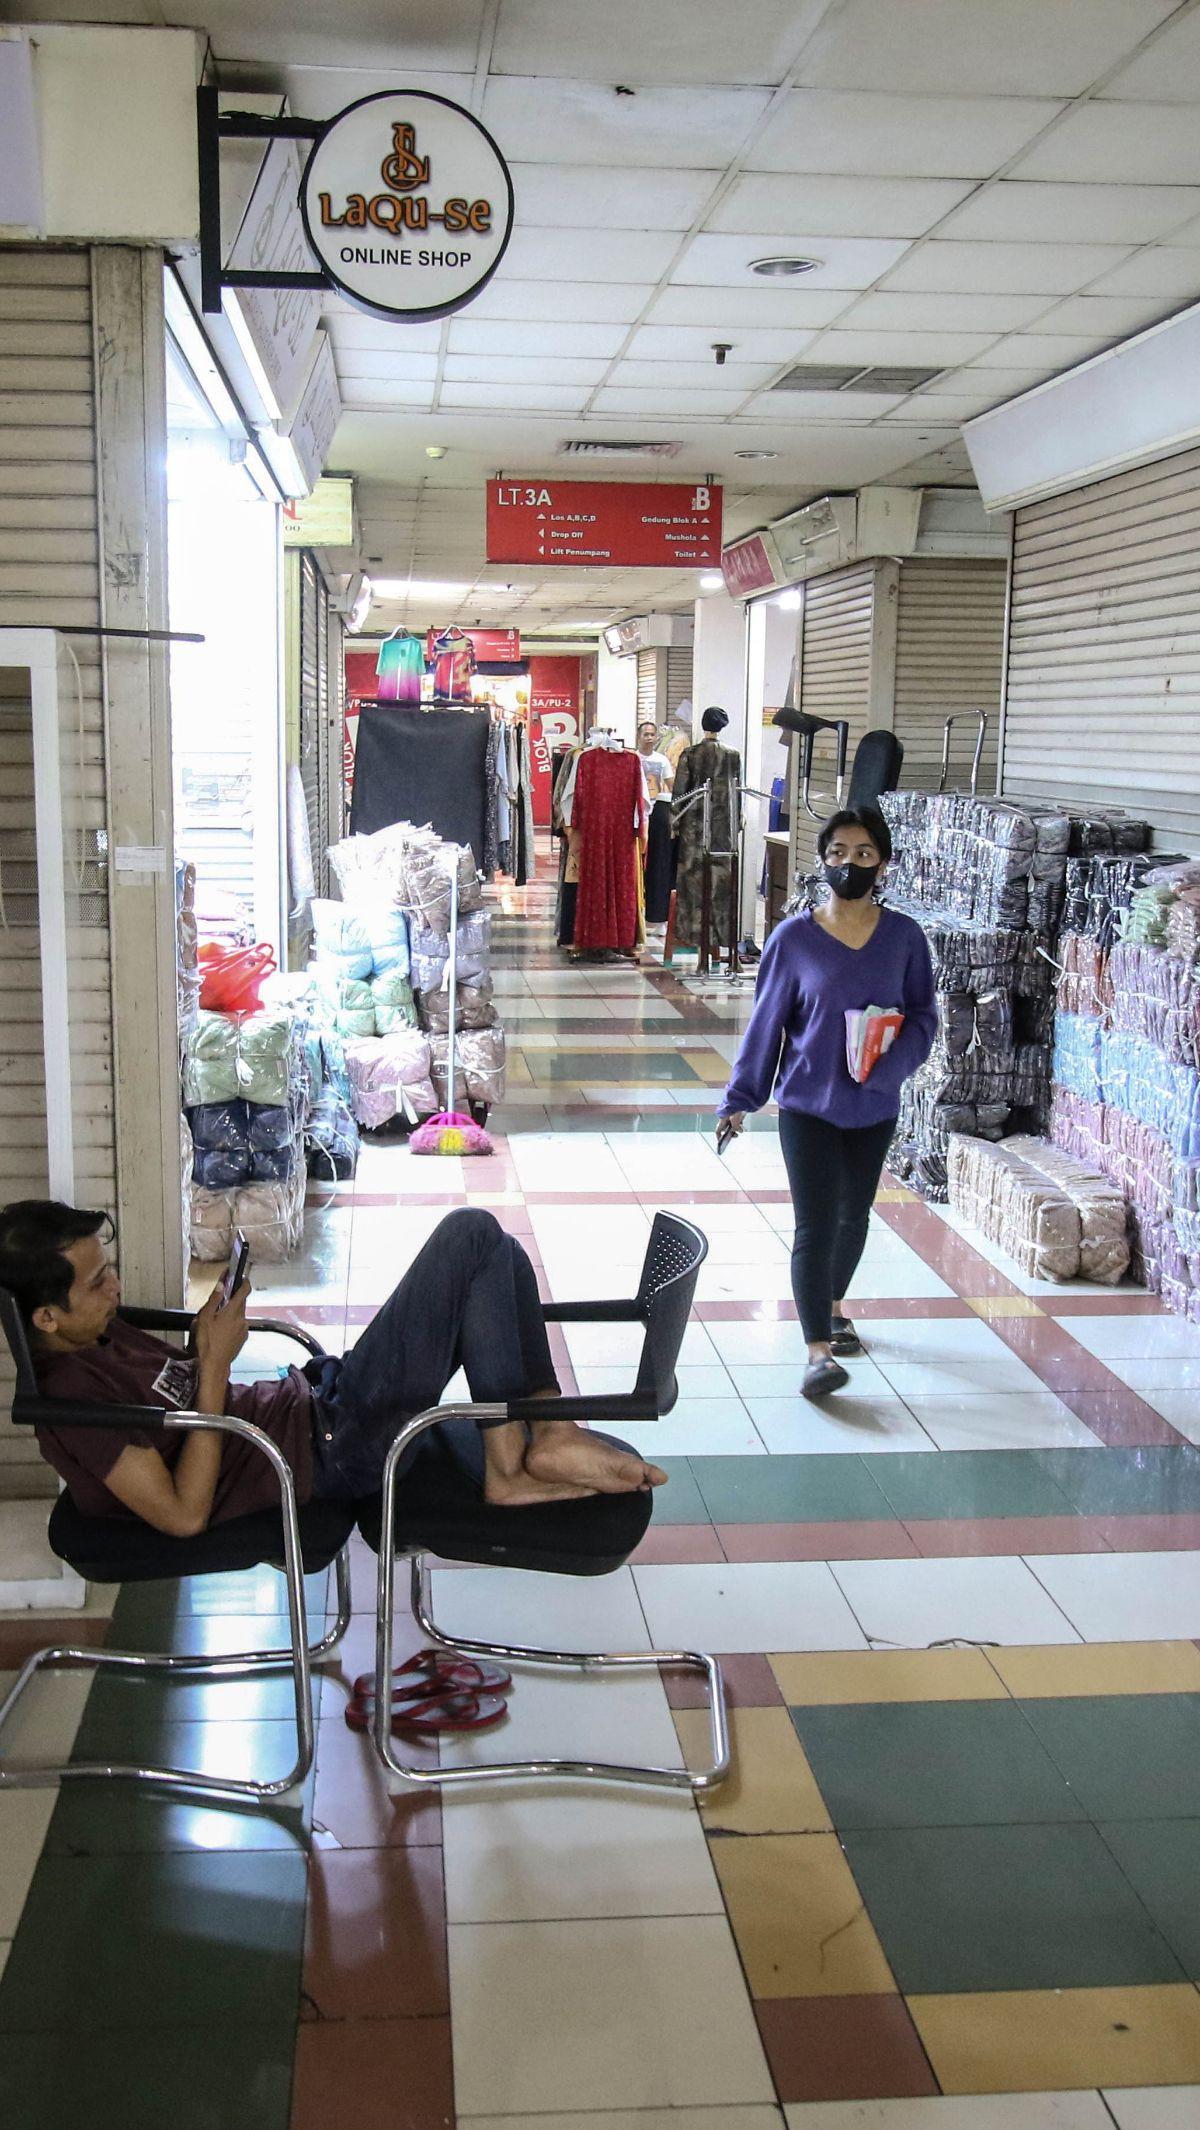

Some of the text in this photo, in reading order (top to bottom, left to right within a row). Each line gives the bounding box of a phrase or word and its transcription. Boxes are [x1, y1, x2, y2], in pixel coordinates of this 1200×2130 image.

[340, 247, 472, 268] ONLINE SHOP
[498, 487, 552, 506] LT.3A
[696, 487, 711, 511] B
[551, 513, 565, 521] Los
[641, 516, 671, 525] Gedung
[551, 531, 584, 540] Drop Off
[664, 533, 697, 541] Mushola
[551, 548, 610, 558] Lift Penumpang
[531, 698, 572, 708] 3A/PU-2
[533, 738, 552, 773] BLOK
